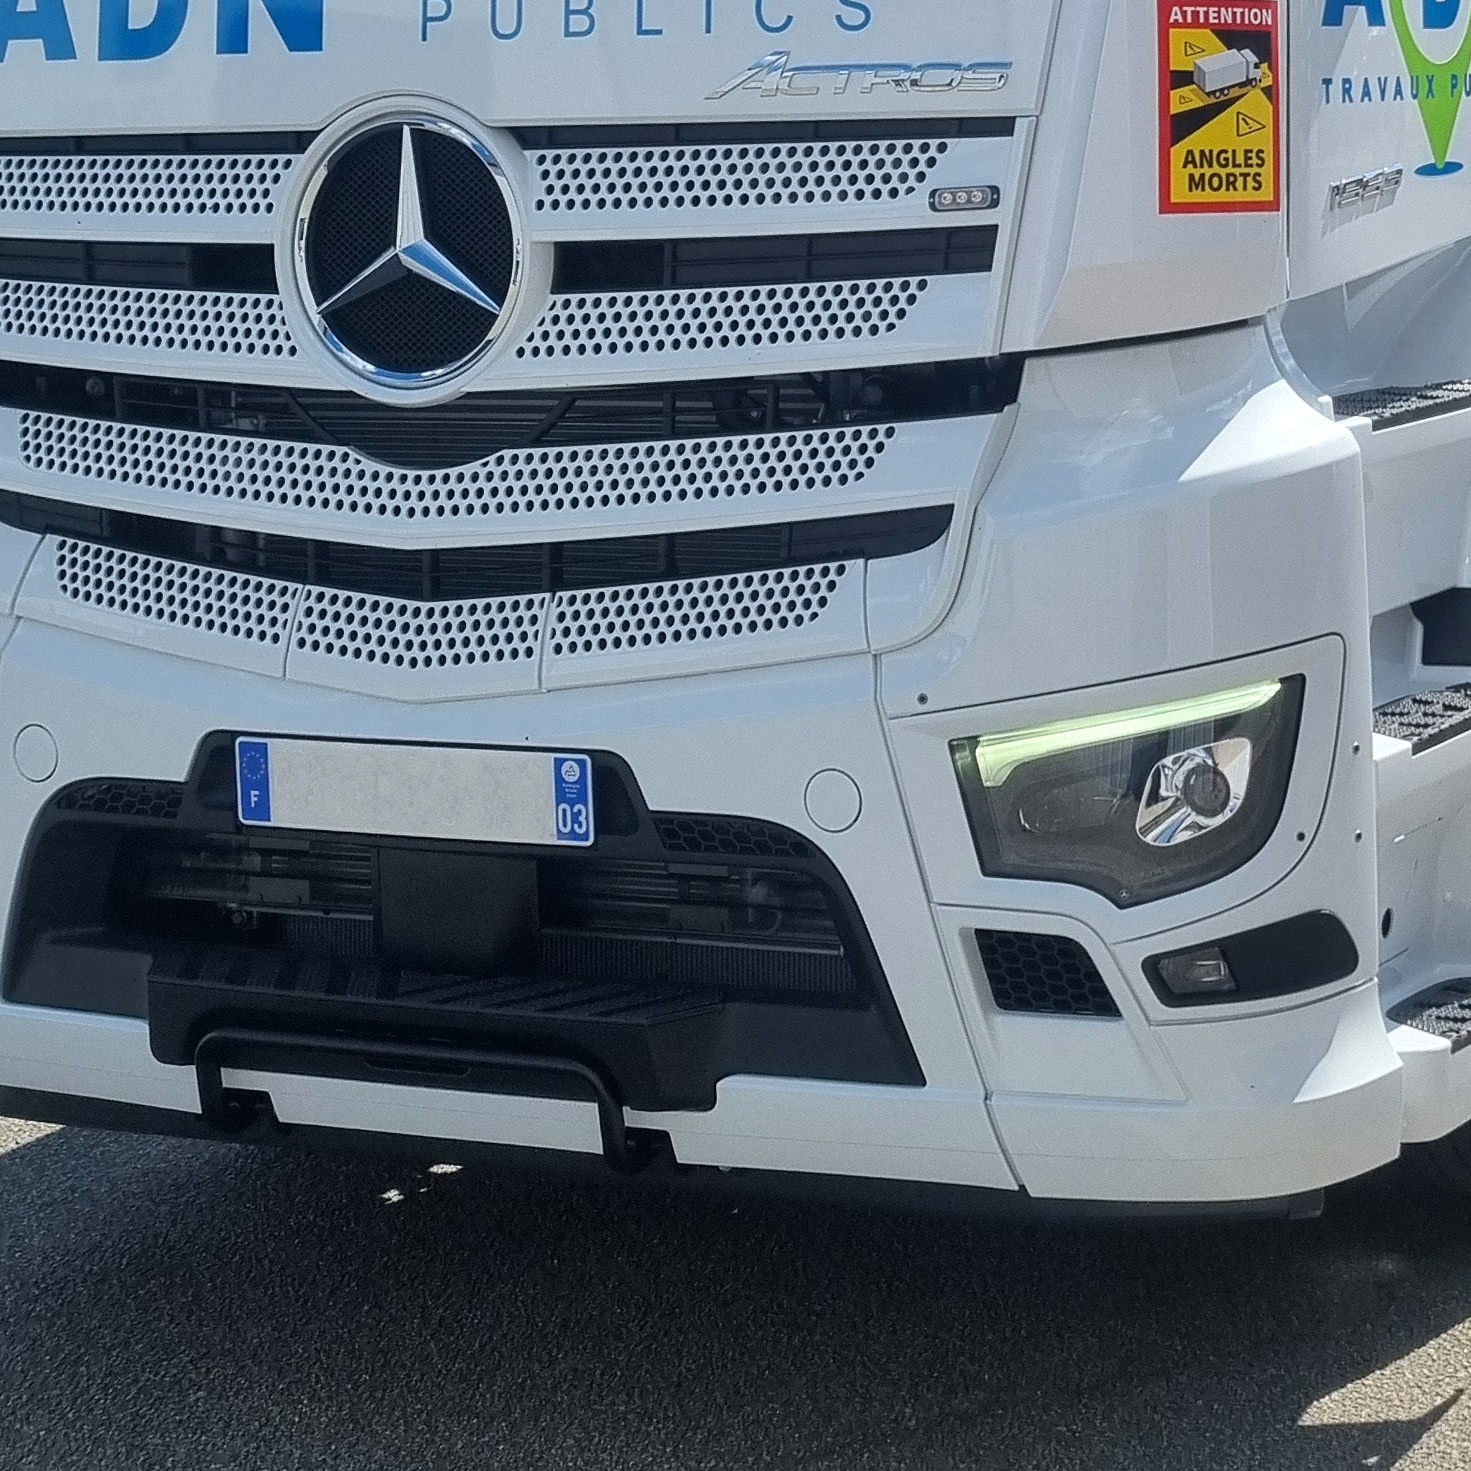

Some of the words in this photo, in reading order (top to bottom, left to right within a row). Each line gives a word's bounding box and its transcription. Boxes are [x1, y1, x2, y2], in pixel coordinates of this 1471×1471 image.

[1169, 6, 1273, 26] ATTENTION
[1321, 74, 1436, 105] TRAVAUX
[1182, 148, 1266, 170] ANGLES
[1187, 172, 1263, 193] MORTS
[250, 790, 260, 807] F
[558, 802, 587, 834] 03
